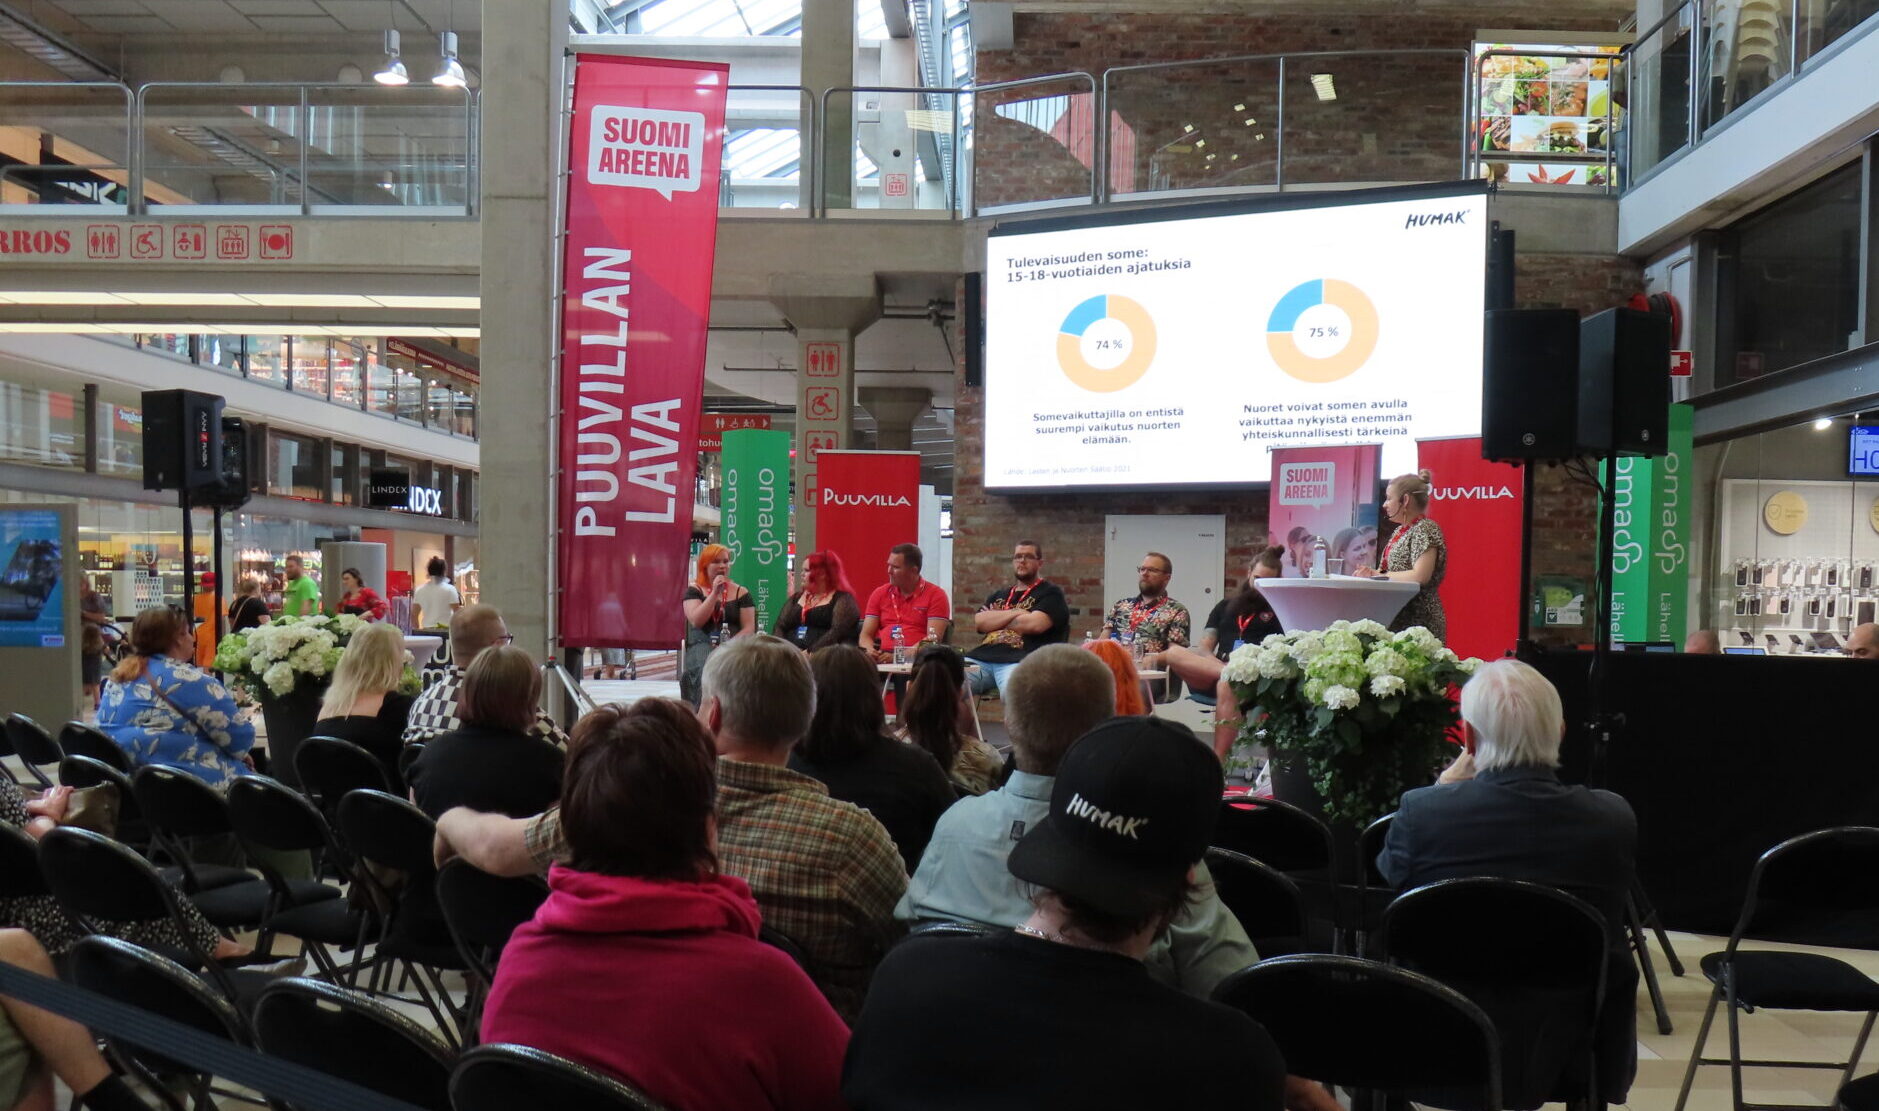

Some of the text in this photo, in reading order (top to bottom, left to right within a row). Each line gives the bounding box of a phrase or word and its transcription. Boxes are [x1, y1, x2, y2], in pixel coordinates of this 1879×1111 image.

[604, 117, 690, 149] SUOMI
[599, 147, 689, 179] AREENA
[1405, 209, 1468, 230] HUMAK
[1007, 248, 1149, 269] Tulevaisuuden some:
[1007, 258, 1191, 282] 15-18-vuotiaiden ajatuksia
[1309, 326, 1339, 338] 75 %
[1096, 340, 1108, 350] 74
[575, 247, 632, 537] PUUVILLAN
[1243, 398, 1408, 413] Nuoret voivat somen avulla
[1033, 407, 1184, 422] Somevaikuttajilla on entistä
[1239, 412, 1412, 427] vaikuttaa nykyistä enemmän
[1035, 421, 1181, 435] suurempi vaikutus nuorten
[1242, 426, 1408, 441] yhteiskunnallisesti tärkeinä
[1082, 435, 1132, 445] elämään.
[625, 398, 681, 524] LAVA
[1286, 468, 1328, 483] SUOMI
[372, 486, 407, 494] LINDEX
[1284, 484, 1328, 499] AREENA
[1066, 792, 1138, 840] HUMAK
